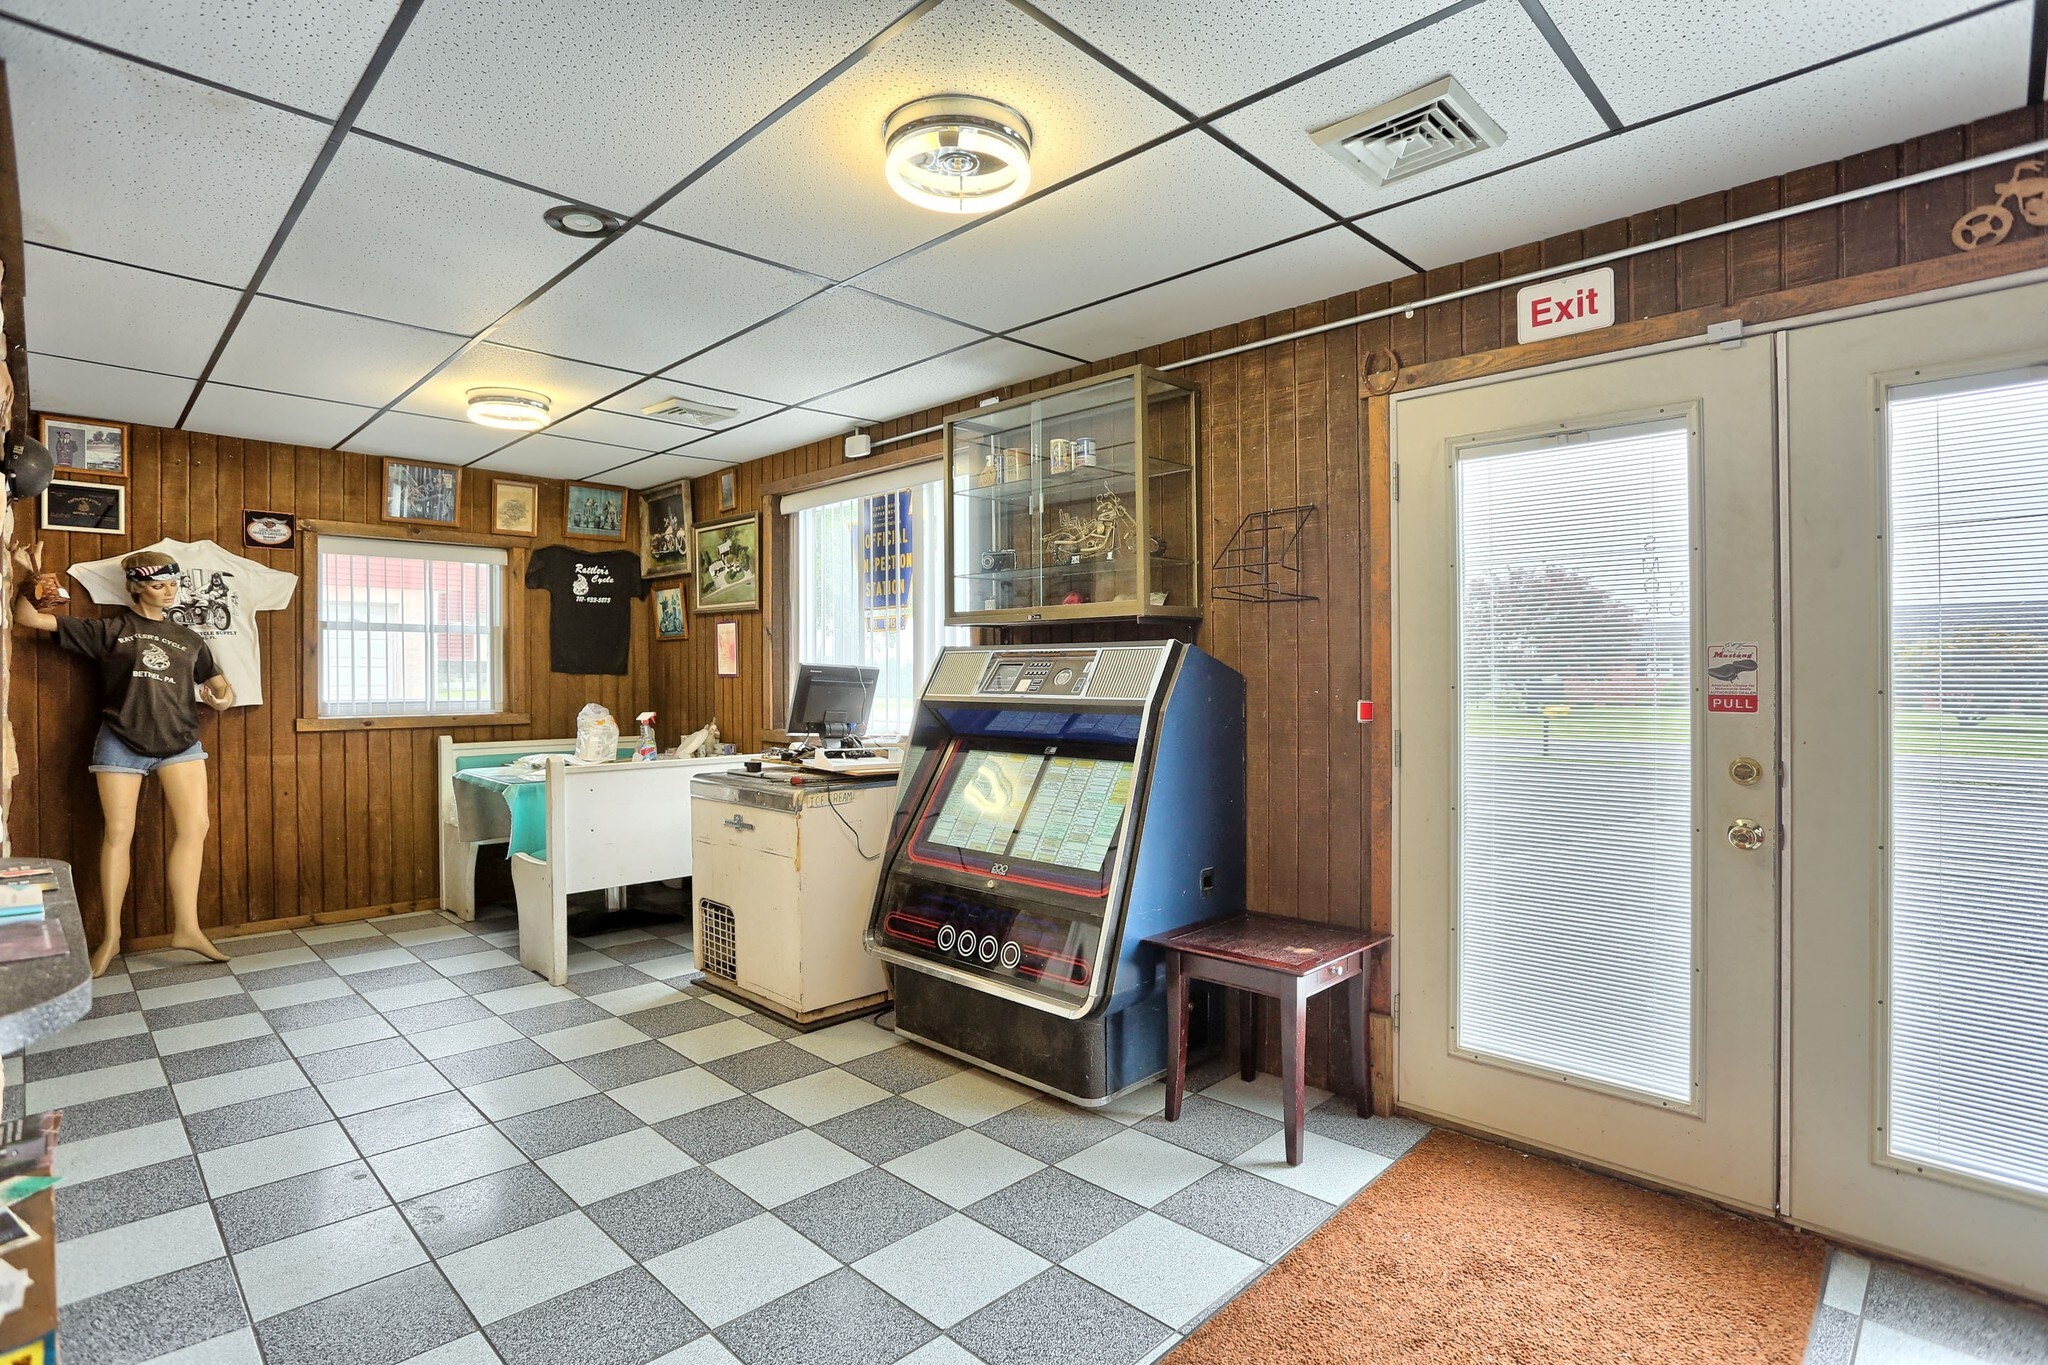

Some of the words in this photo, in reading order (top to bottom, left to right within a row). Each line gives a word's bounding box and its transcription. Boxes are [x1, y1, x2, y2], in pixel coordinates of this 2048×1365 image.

[1531, 288, 1599, 328] Exit
[575, 563, 609, 574] Rattler's
[591, 574, 614, 584] Cycle
[117, 633, 160, 644] RATTLER'S
[161, 638, 187, 651] CYCLE
[1713, 651, 1753, 659] Mustang
[1712, 698, 1753, 709] PULL
[829, 791, 853, 803] REAM
